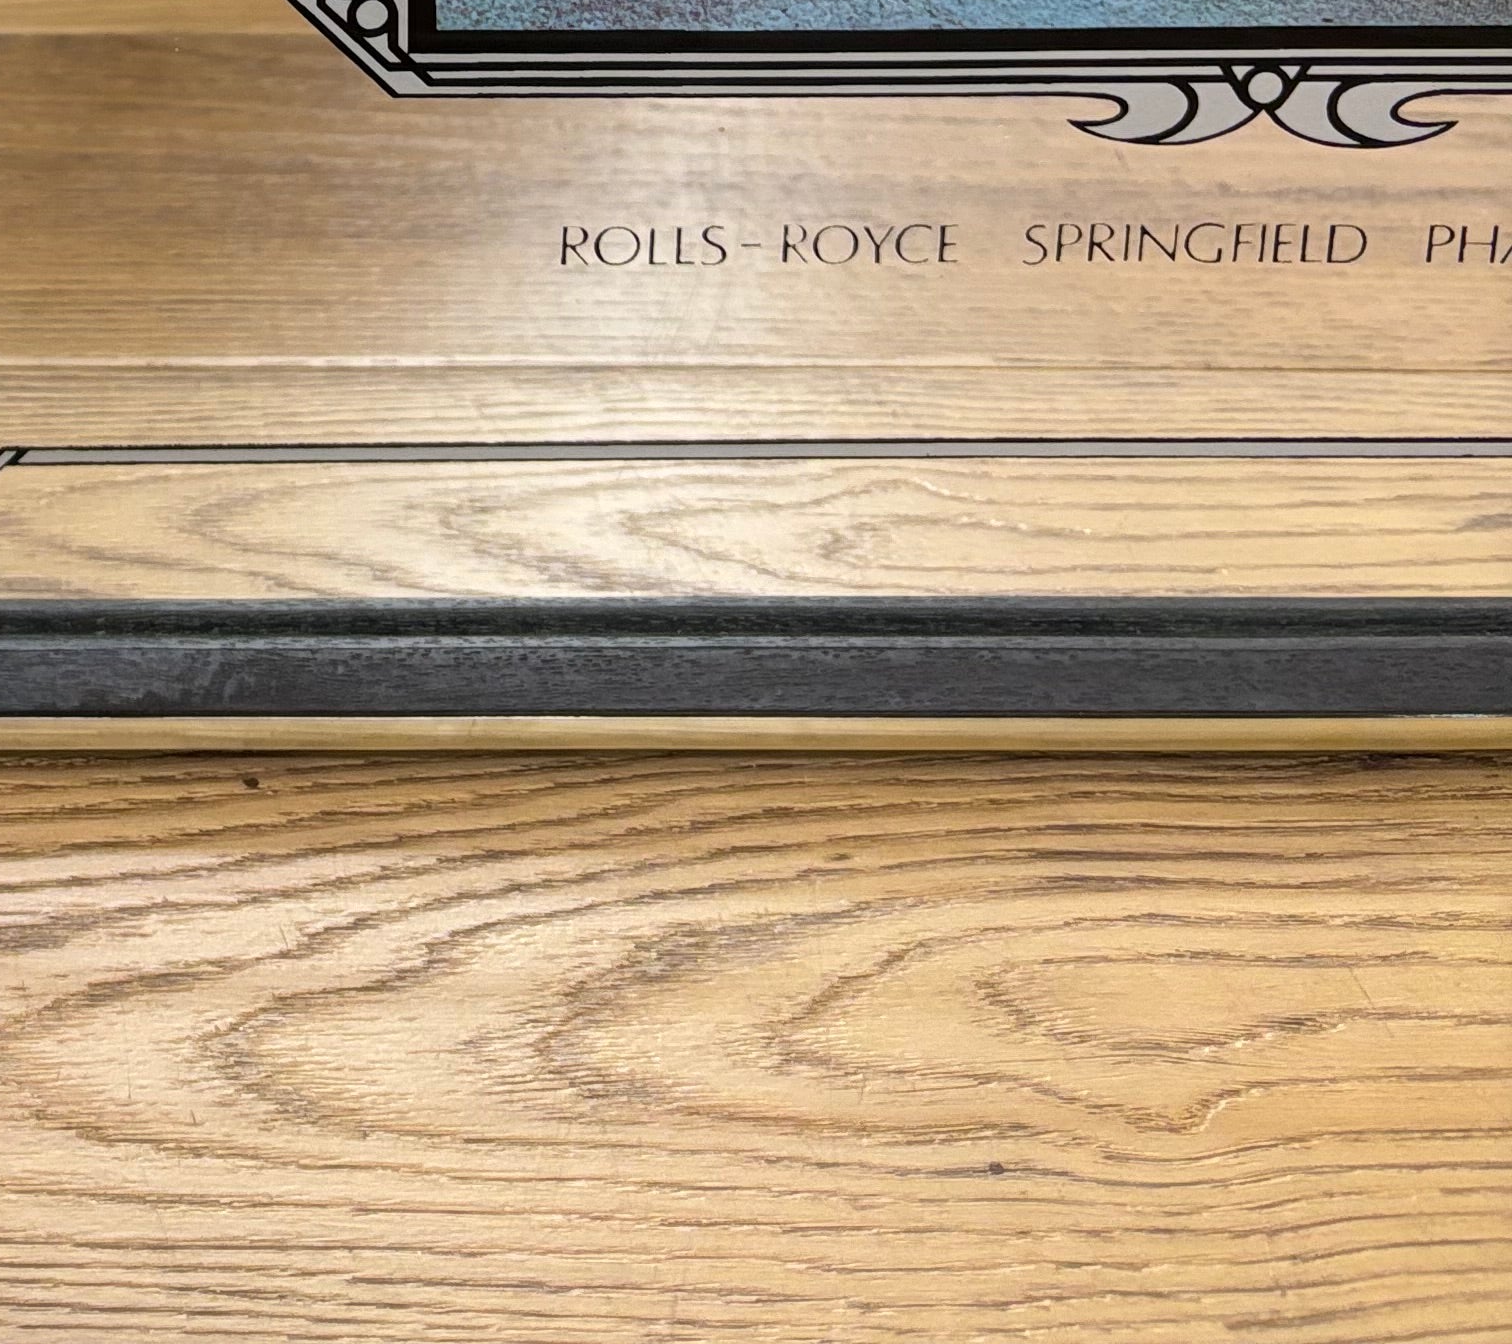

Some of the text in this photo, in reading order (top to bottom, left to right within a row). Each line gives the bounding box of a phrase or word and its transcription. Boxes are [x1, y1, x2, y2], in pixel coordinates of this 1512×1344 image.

[559, 222, 1512, 266] ROLLS-ROYCE SPRINGFIELD PH
